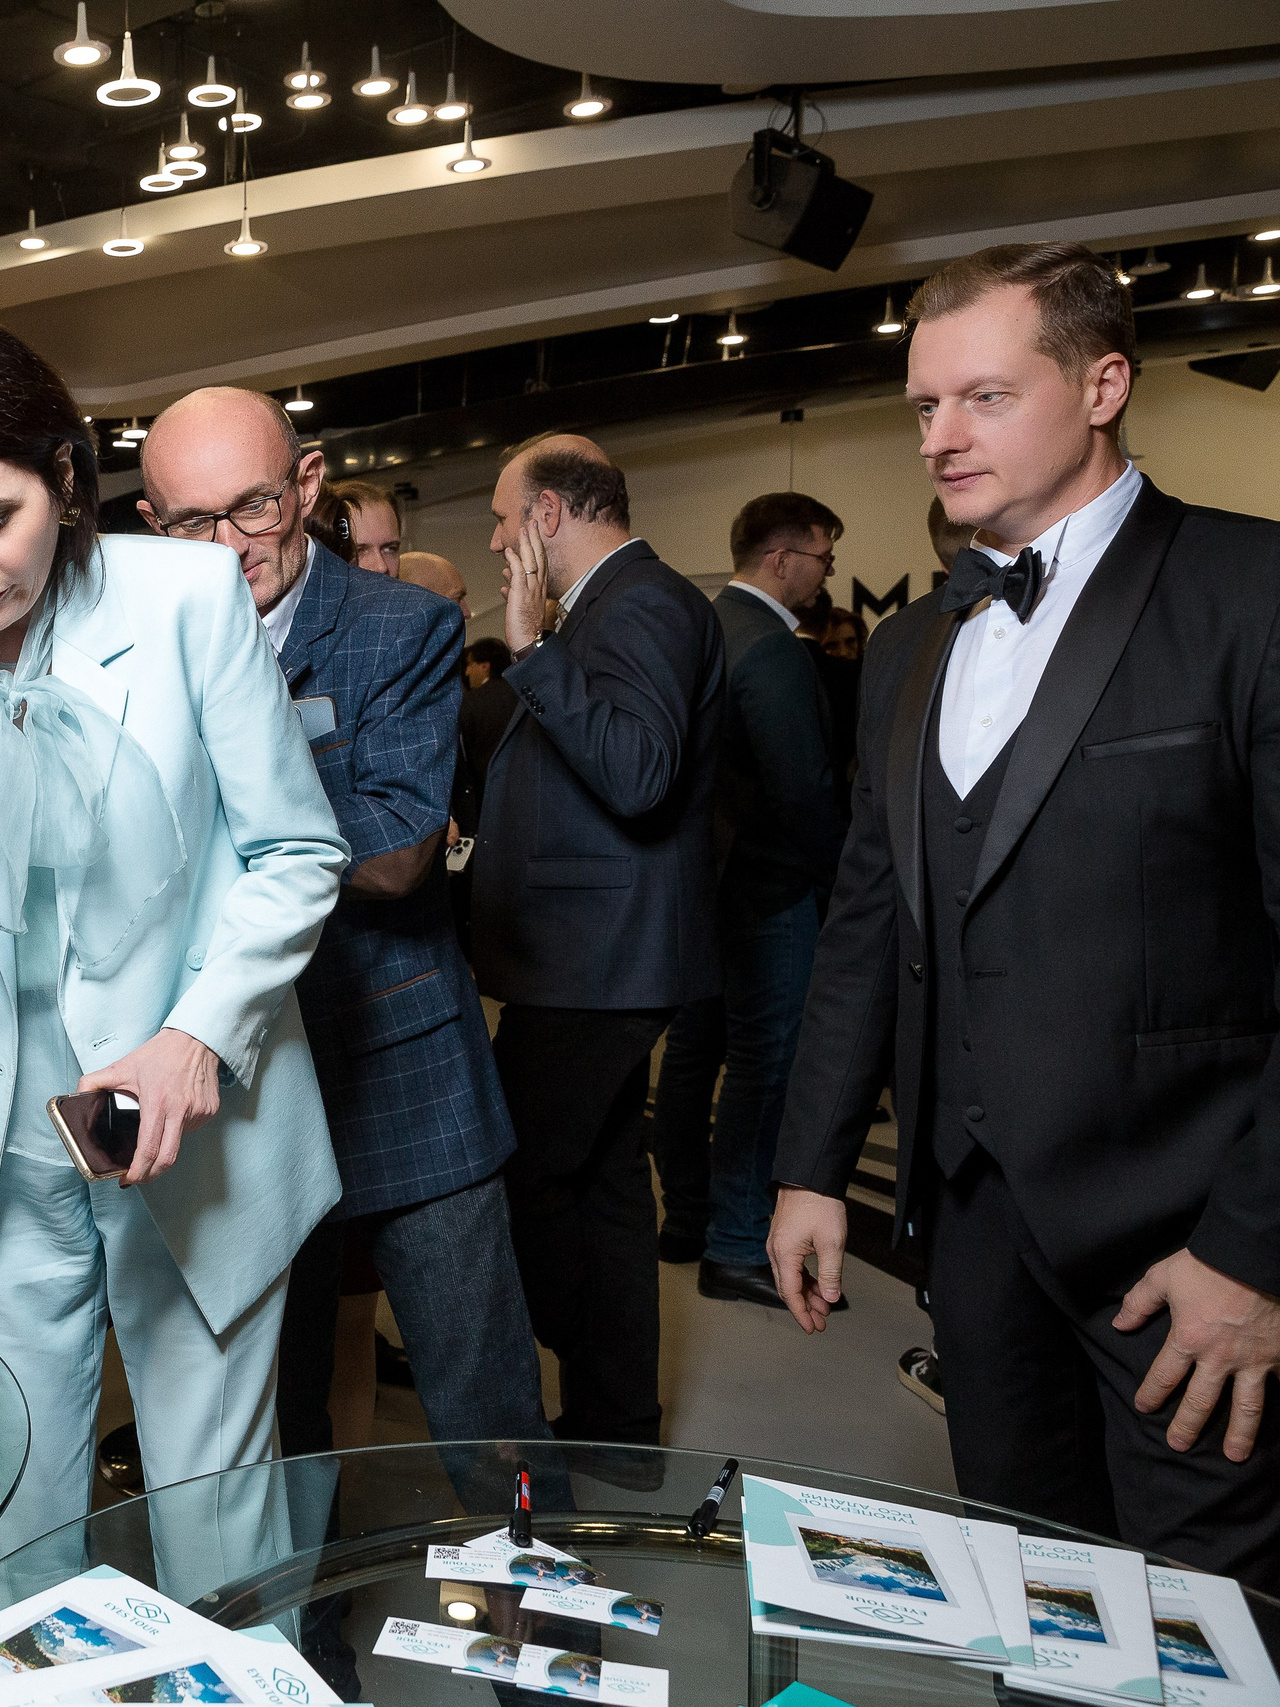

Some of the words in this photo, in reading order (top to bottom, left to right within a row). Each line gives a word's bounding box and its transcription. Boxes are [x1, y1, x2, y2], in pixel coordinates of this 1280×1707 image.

[799, 1498, 918, 1526] ТУРОПЕРАТОР
[801, 1491, 913, 1519] РСО-АЛАНИЯ
[845, 1593, 886, 1608] TOUR
[890, 1603, 928, 1617] EYES
[103, 1602, 130, 1619] EYES
[129, 1616, 160, 1636] TOUR
[246, 1667, 269, 1690] EYES
[265, 1689, 284, 1705] TO
